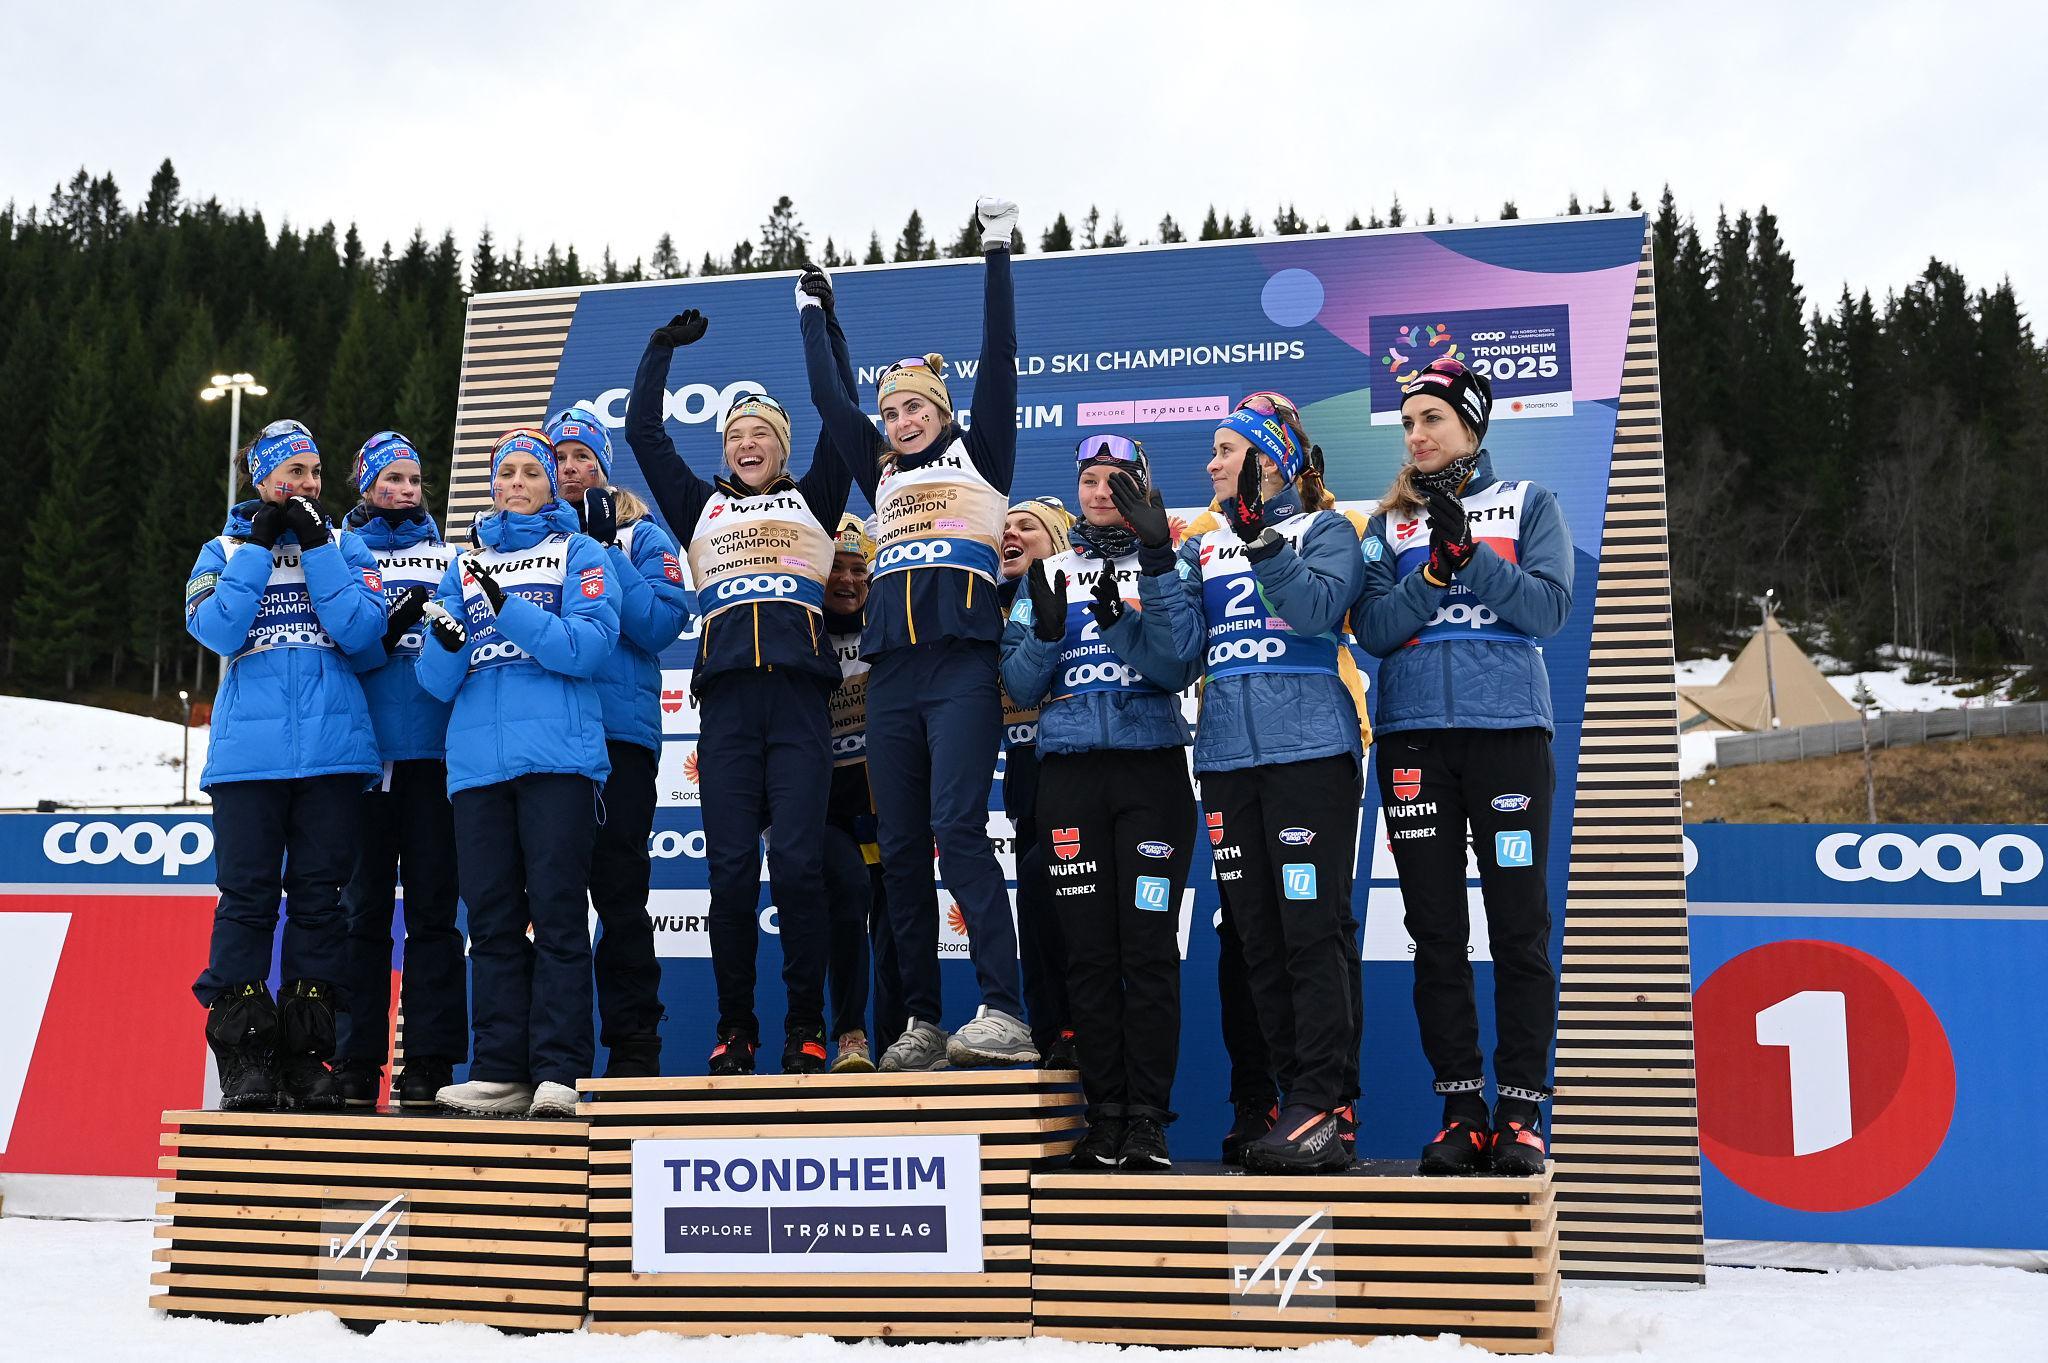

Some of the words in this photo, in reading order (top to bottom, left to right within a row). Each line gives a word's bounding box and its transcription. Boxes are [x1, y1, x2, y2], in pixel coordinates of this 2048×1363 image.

[1471, 332, 1506, 341] coop
[954, 354, 1045, 378] WLD
[1051, 353, 1089, 373] SKI
[1096, 341, 1305, 370] CHAMPIONSHIPS
[1472, 343, 1556, 357] TRONDHEIM
[1472, 356, 1559, 380] 2025
[1085, 409, 1125, 418] EXPLORE
[1142, 404, 1221, 418] TRØNDELAG
[916, 489, 958, 502] 2025
[882, 500, 947, 525] CHAMPION
[1467, 506, 1514, 522] RTH
[711, 527, 758, 547] WORLD
[760, 527, 799, 541] 2025
[877, 521, 932, 545] RONDHEIM
[717, 538, 791, 555] CHAMPION
[879, 540, 952, 568] coop
[583, 568, 601, 576] NOR
[706, 556, 777, 578] TRONDHEIM
[1077, 570, 1140, 586] WRT
[260, 592, 299, 605] ORLD
[717, 575, 798, 600] coop
[1225, 576, 1254, 617] 2
[248, 623, 318, 638] RONDHEIM
[1207, 637, 1287, 667] coop
[1064, 662, 1143, 687] coop
[1387, 803, 1437, 818] WÜRTH
[1400, 827, 1437, 839] TERREX
[43, 821, 215, 876] coop
[1499, 836, 1530, 862] TQ
[1048, 861, 1097, 877] WÜRTH
[1815, 832, 2044, 896] coop
[1062, 884, 1096, 896] TERREX
[1138, 881, 1163, 907] TQ
[1286, 869, 1311, 895] TQ
[650, 915, 710, 933] WÜRT
[1756, 990, 1853, 1157] 1
[663, 1156, 946, 1193] TRONDHEIM
[680, 1225, 753, 1237] EXPLORE
[783, 1222, 932, 1246] TRØNDELAG
[329, 1237, 399, 1261] FIS
[1233, 1265, 1324, 1291] FIS
